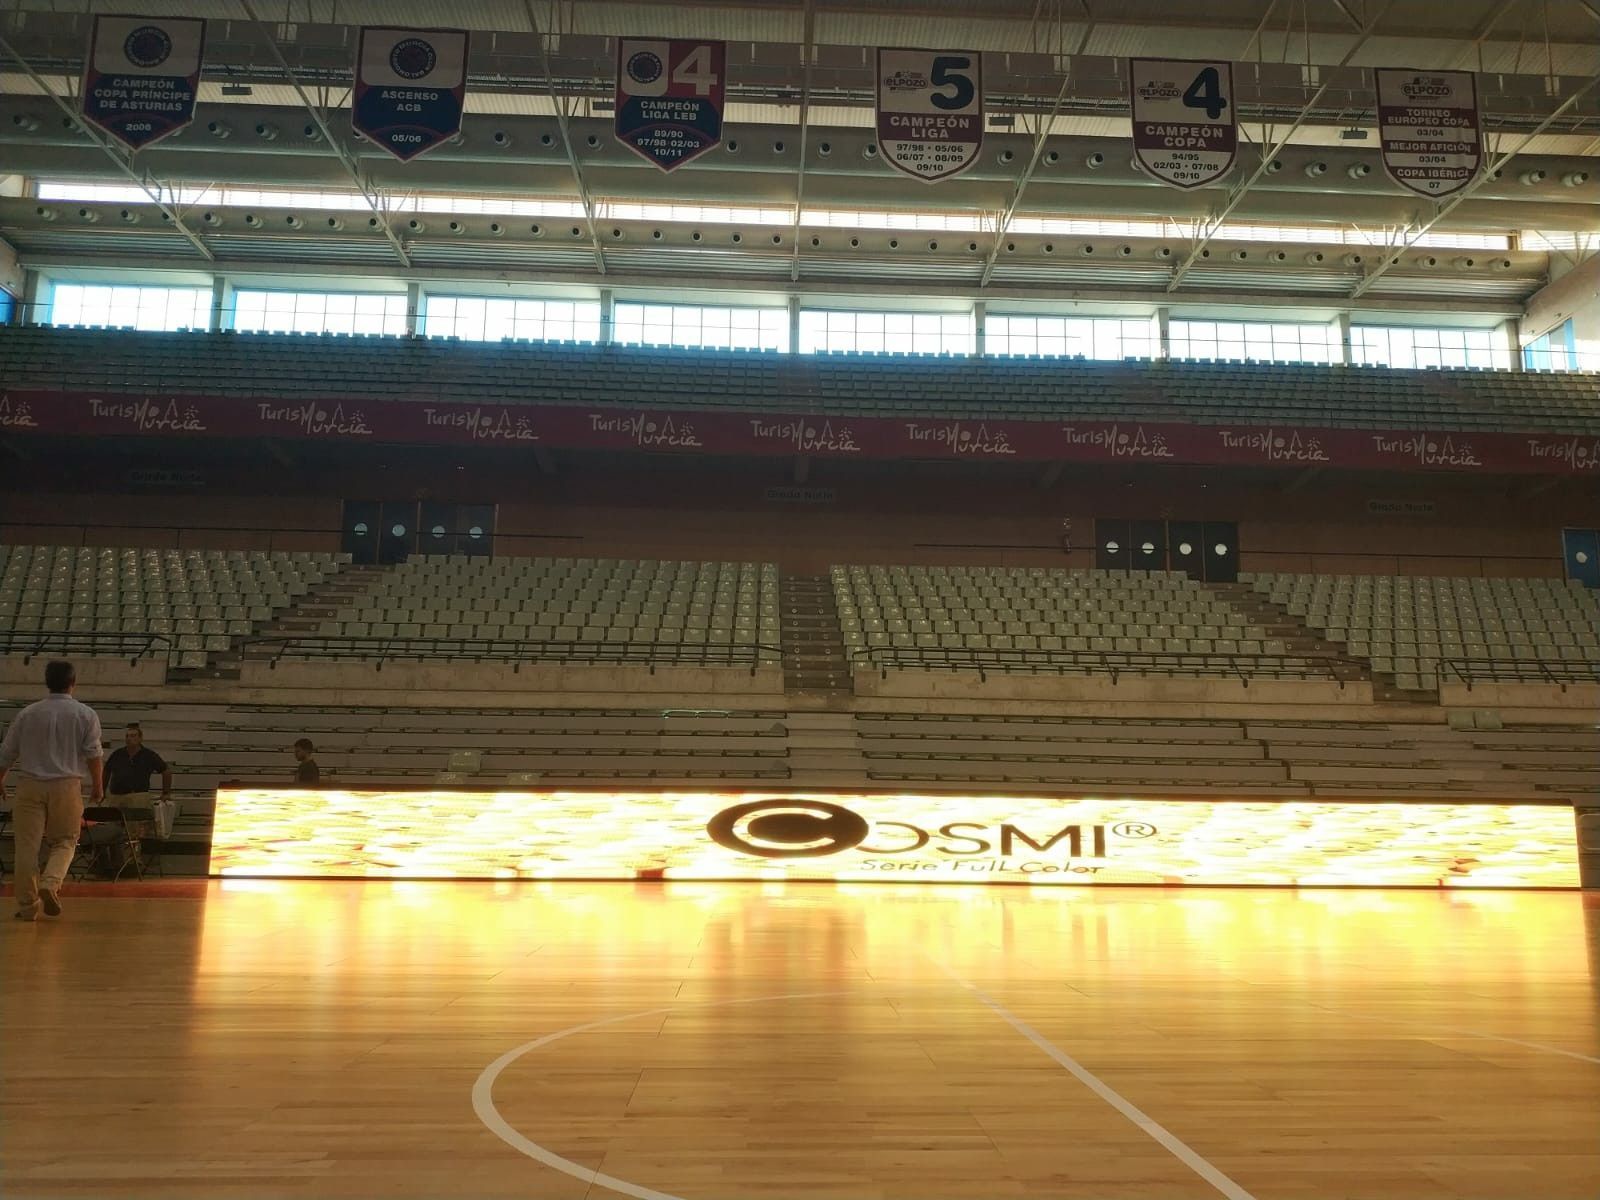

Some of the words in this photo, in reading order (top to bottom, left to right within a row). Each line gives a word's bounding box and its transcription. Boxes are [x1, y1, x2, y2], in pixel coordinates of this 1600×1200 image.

[672, 45, 718, 95] 4
[113, 78, 175, 89] CAMPEÓN
[930, 56, 974, 110] 5
[94, 89, 127, 98] COPA
[132, 89, 190, 101] PRÍNCIPE
[381, 90, 438, 100] ASCENSO
[1182, 67, 1227, 119] 4
[100, 100, 116, 109] DE
[121, 101, 182, 111] ASTURIAS
[396, 103, 421, 112] ACB
[640, 101, 700, 111] CAMPEÓN
[642, 111, 670, 120] LIGA
[674, 112, 697, 121] LEB
[1406, 109, 1450, 117] TORNEO
[890, 116, 970, 128] CAMPEÓN
[1388, 117, 1440, 125] EUROPEO
[1443, 118, 1470, 126] COPA
[654, 130, 683, 138] 89/90
[912, 128, 949, 138] LIGA
[1145, 126, 1223, 138] CAMPEÓN
[1417, 129, 1444, 137] 03/04
[392, 134, 421, 143] 05/06
[670, 139, 700, 148] 02/03
[1164, 137, 1206, 147] COPA
[1390, 142, 1427, 150] MEJOR
[654, 148, 682, 156] 10/11
[1172, 153, 1199, 161] 94/95
[896, 153, 924, 161] 06/07
[935, 154, 963, 162] 08/09
[1153, 162, 1181, 170] 02/03
[1397, 169, 1425, 177] COPA
[861, 858, 937, 872] Serie
[1019, 861, 1106, 874] Color
